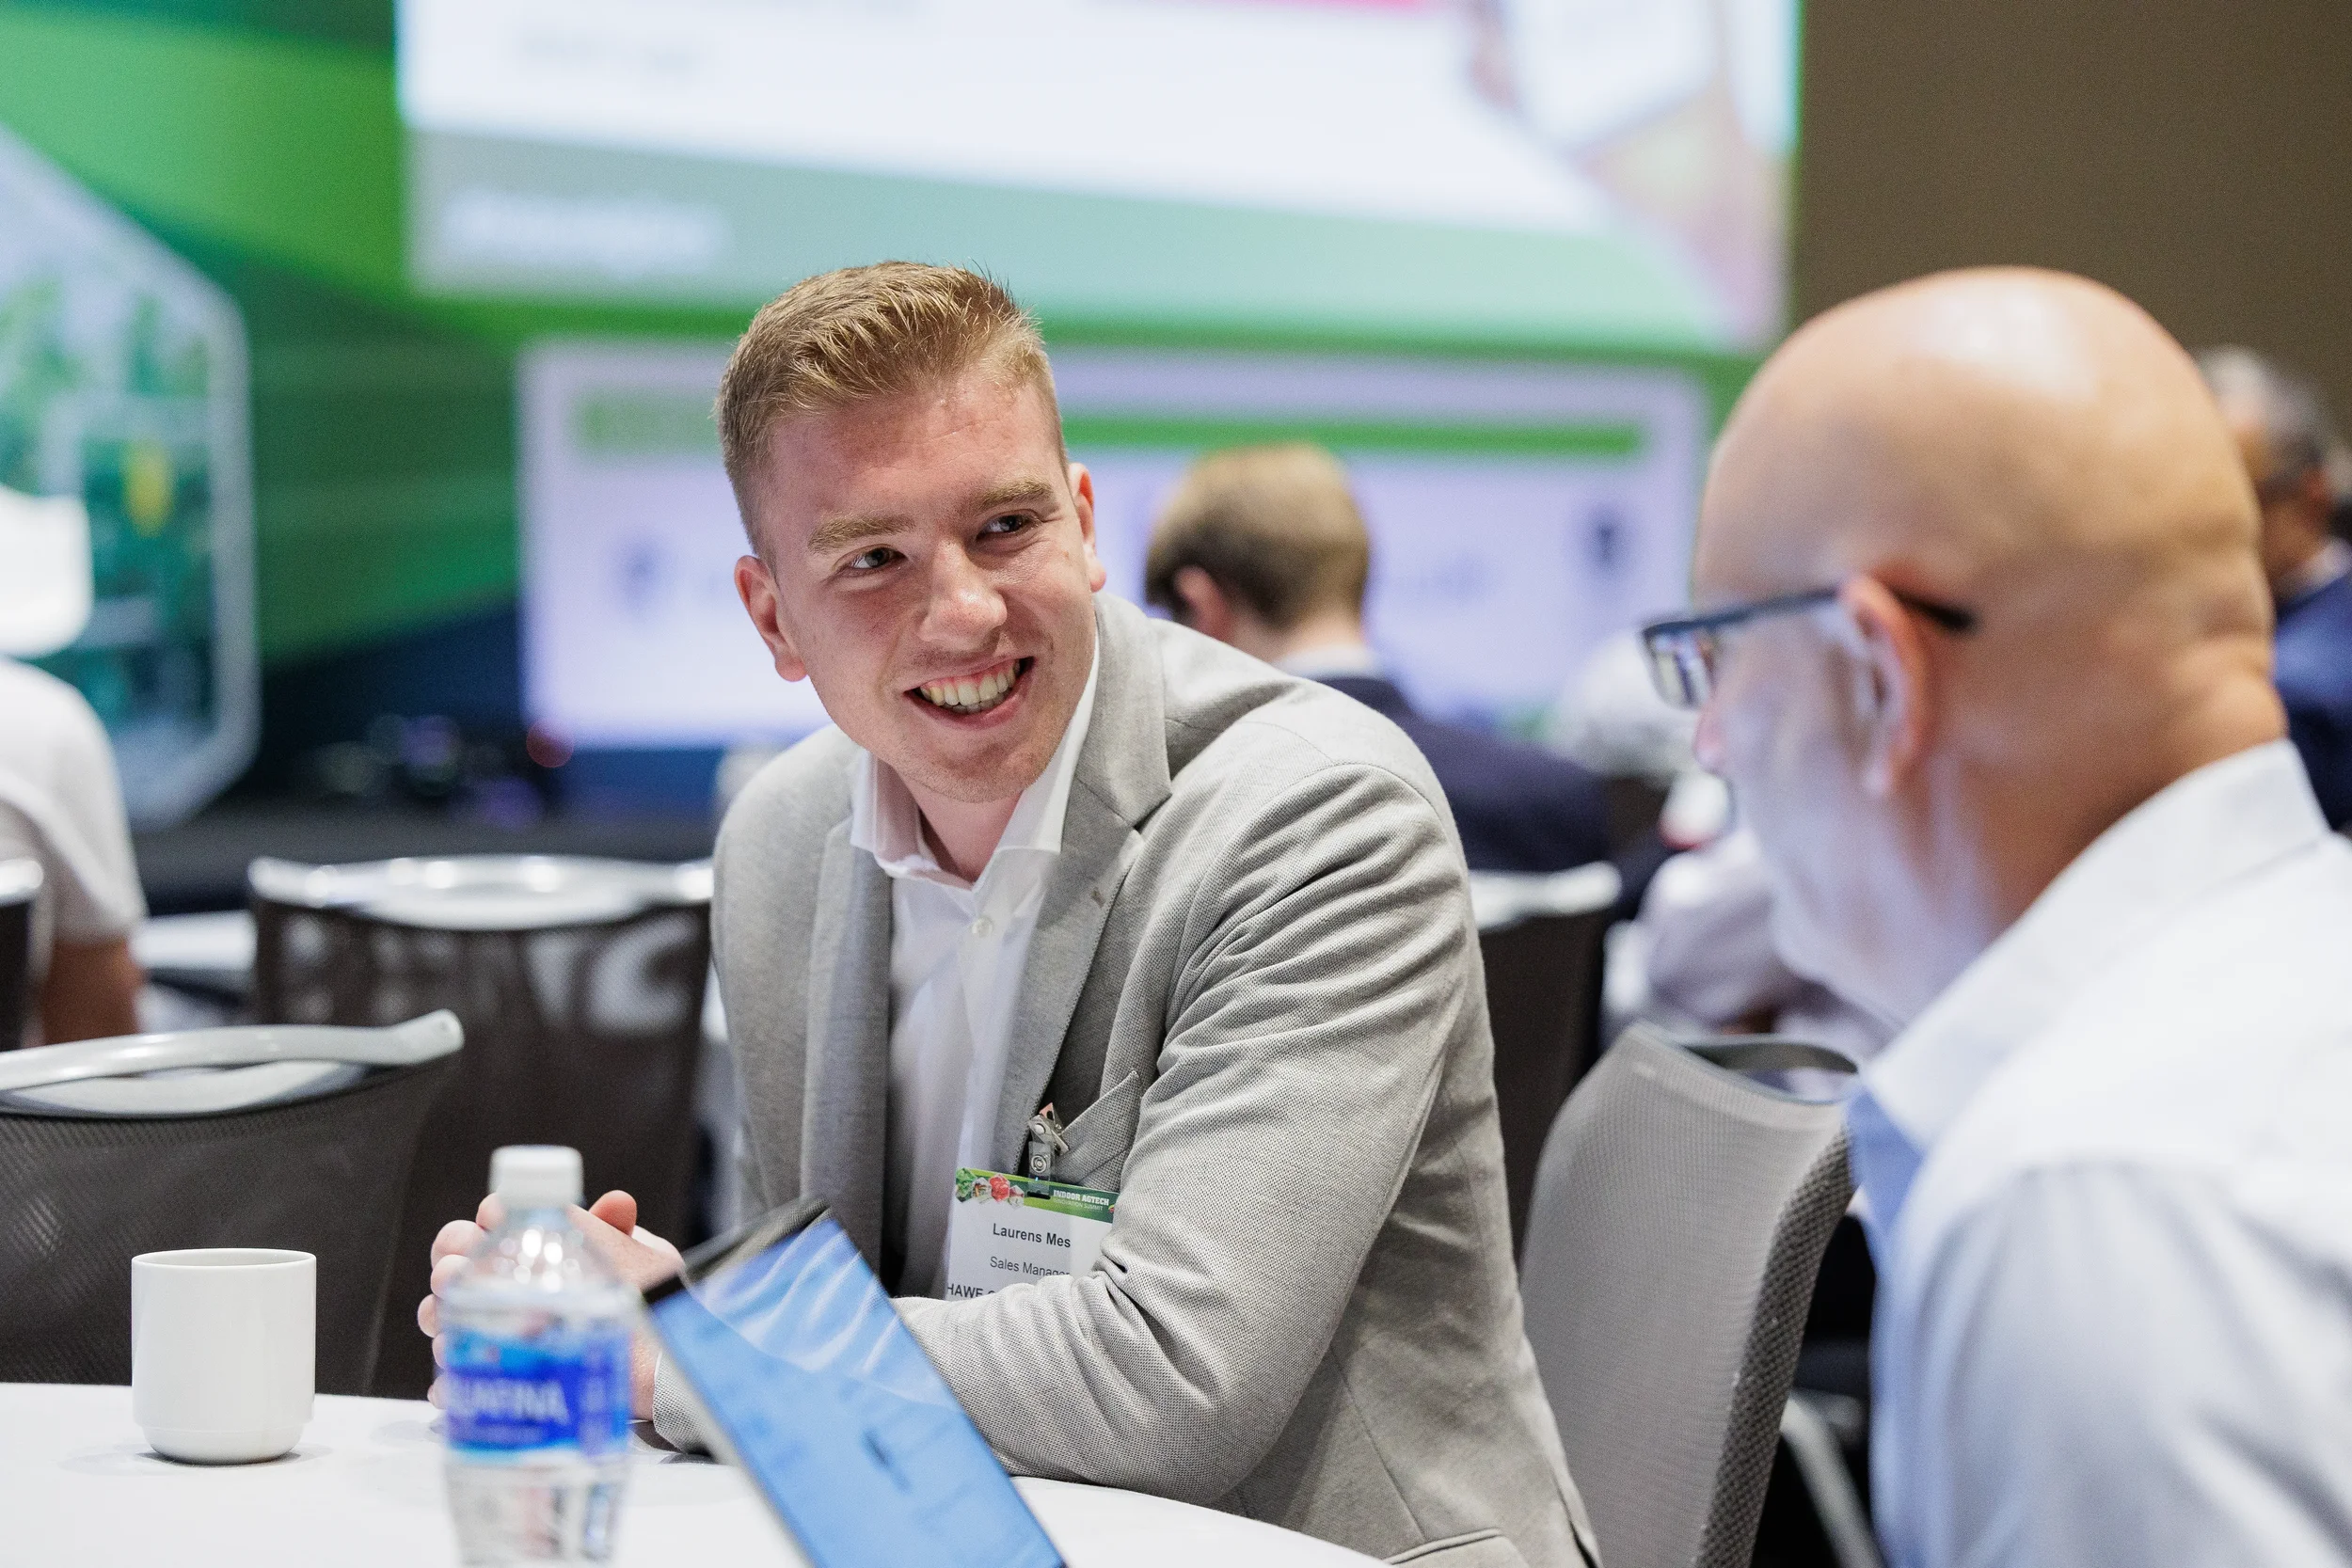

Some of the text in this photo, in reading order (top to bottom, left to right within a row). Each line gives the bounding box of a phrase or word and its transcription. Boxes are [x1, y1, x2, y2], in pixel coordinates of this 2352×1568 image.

[1053, 1189, 1110, 1206] INDOOR AGTECH
[993, 1223, 1072, 1248] Laurens Mes
[990, 1256, 1020, 1272] Sales
